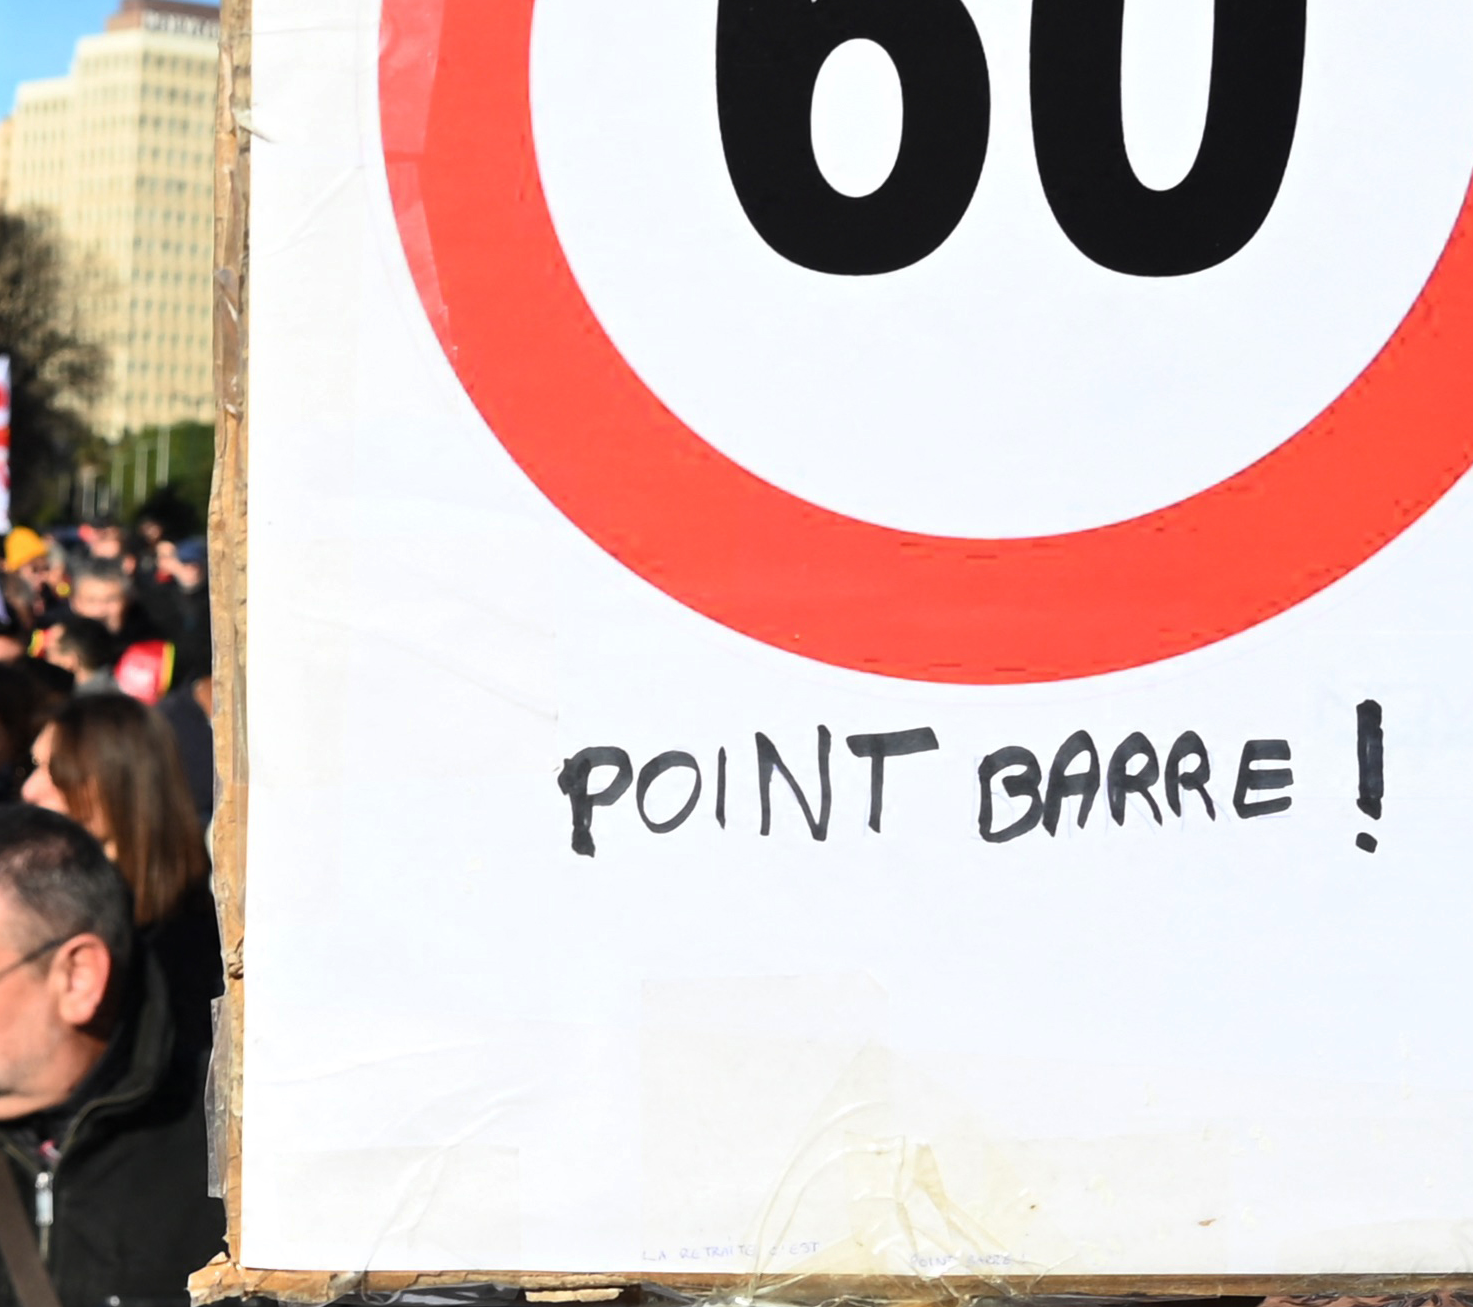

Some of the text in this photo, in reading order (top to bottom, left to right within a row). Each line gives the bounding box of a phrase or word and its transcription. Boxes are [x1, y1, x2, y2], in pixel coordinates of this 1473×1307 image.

[557, 699, 1386, 857] POINT BARRE !
